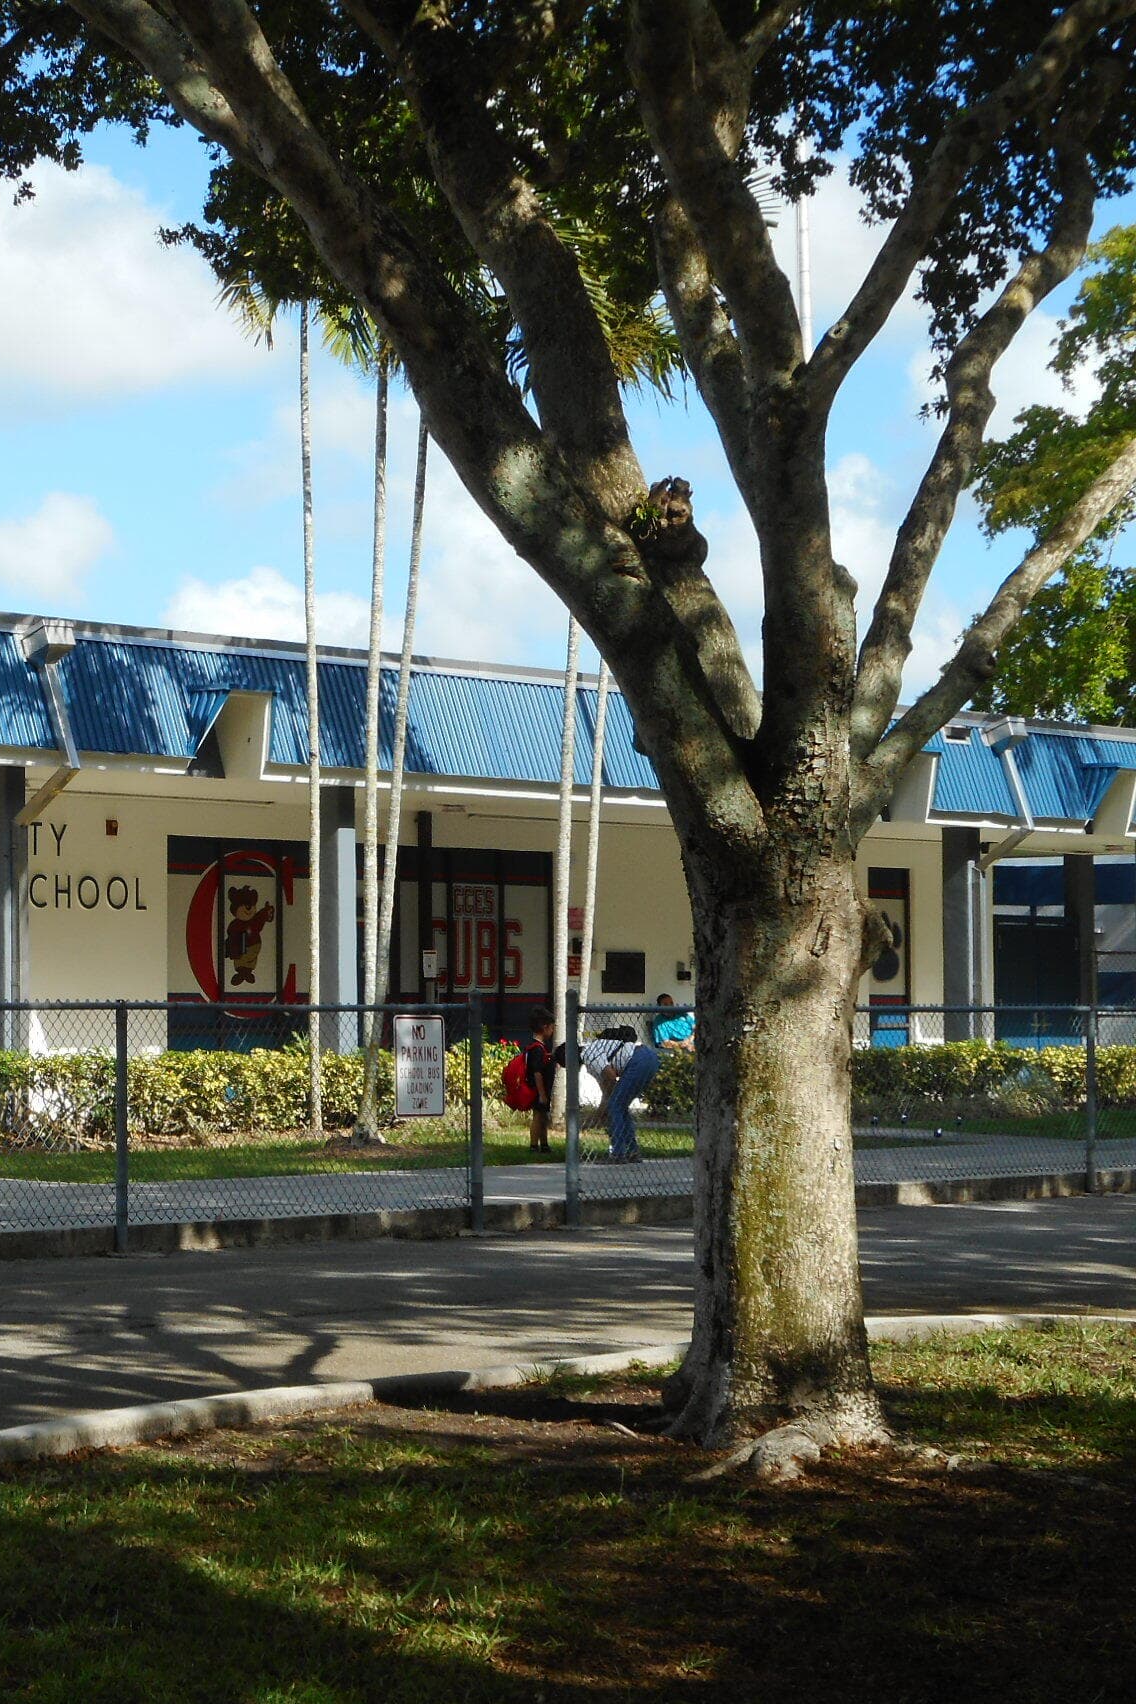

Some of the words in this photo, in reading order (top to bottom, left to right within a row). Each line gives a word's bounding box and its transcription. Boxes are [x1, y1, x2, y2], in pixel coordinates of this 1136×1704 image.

[29, 821, 68, 857] TY
[29, 874, 148, 911] CHOOL
[411, 1024, 426, 1040] NO
[401, 1046, 438, 1062] PARKING
[399, 1067, 424, 1079] SCHOOL
[427, 1066, 440, 1079] BUS
[407, 1083, 434, 1095] LOADING
[411, 1098, 428, 1109] ZONE
